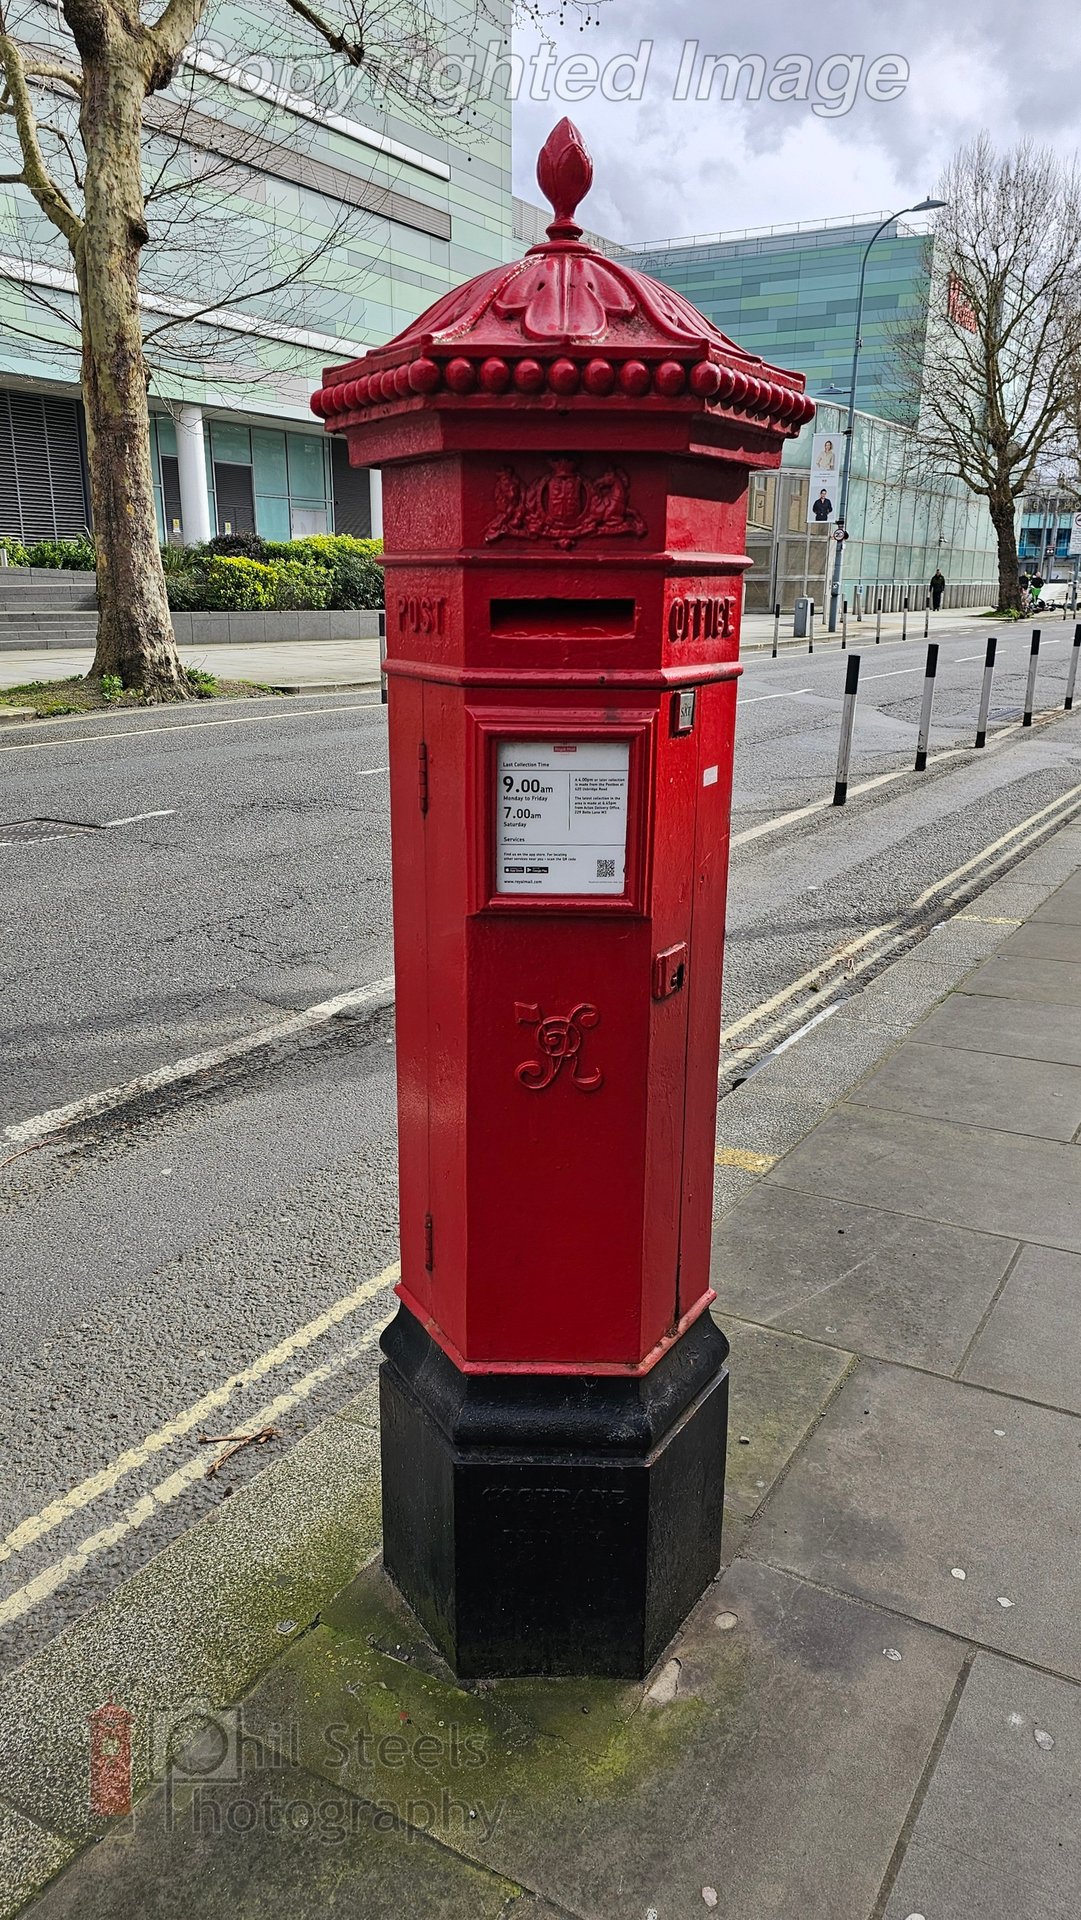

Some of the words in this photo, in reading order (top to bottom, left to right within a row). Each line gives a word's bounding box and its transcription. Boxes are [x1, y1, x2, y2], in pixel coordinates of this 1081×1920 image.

[398, 596, 447, 635] POST
[503, 776, 554, 793] 9.00am
[503, 806, 542, 819] 7.00am
